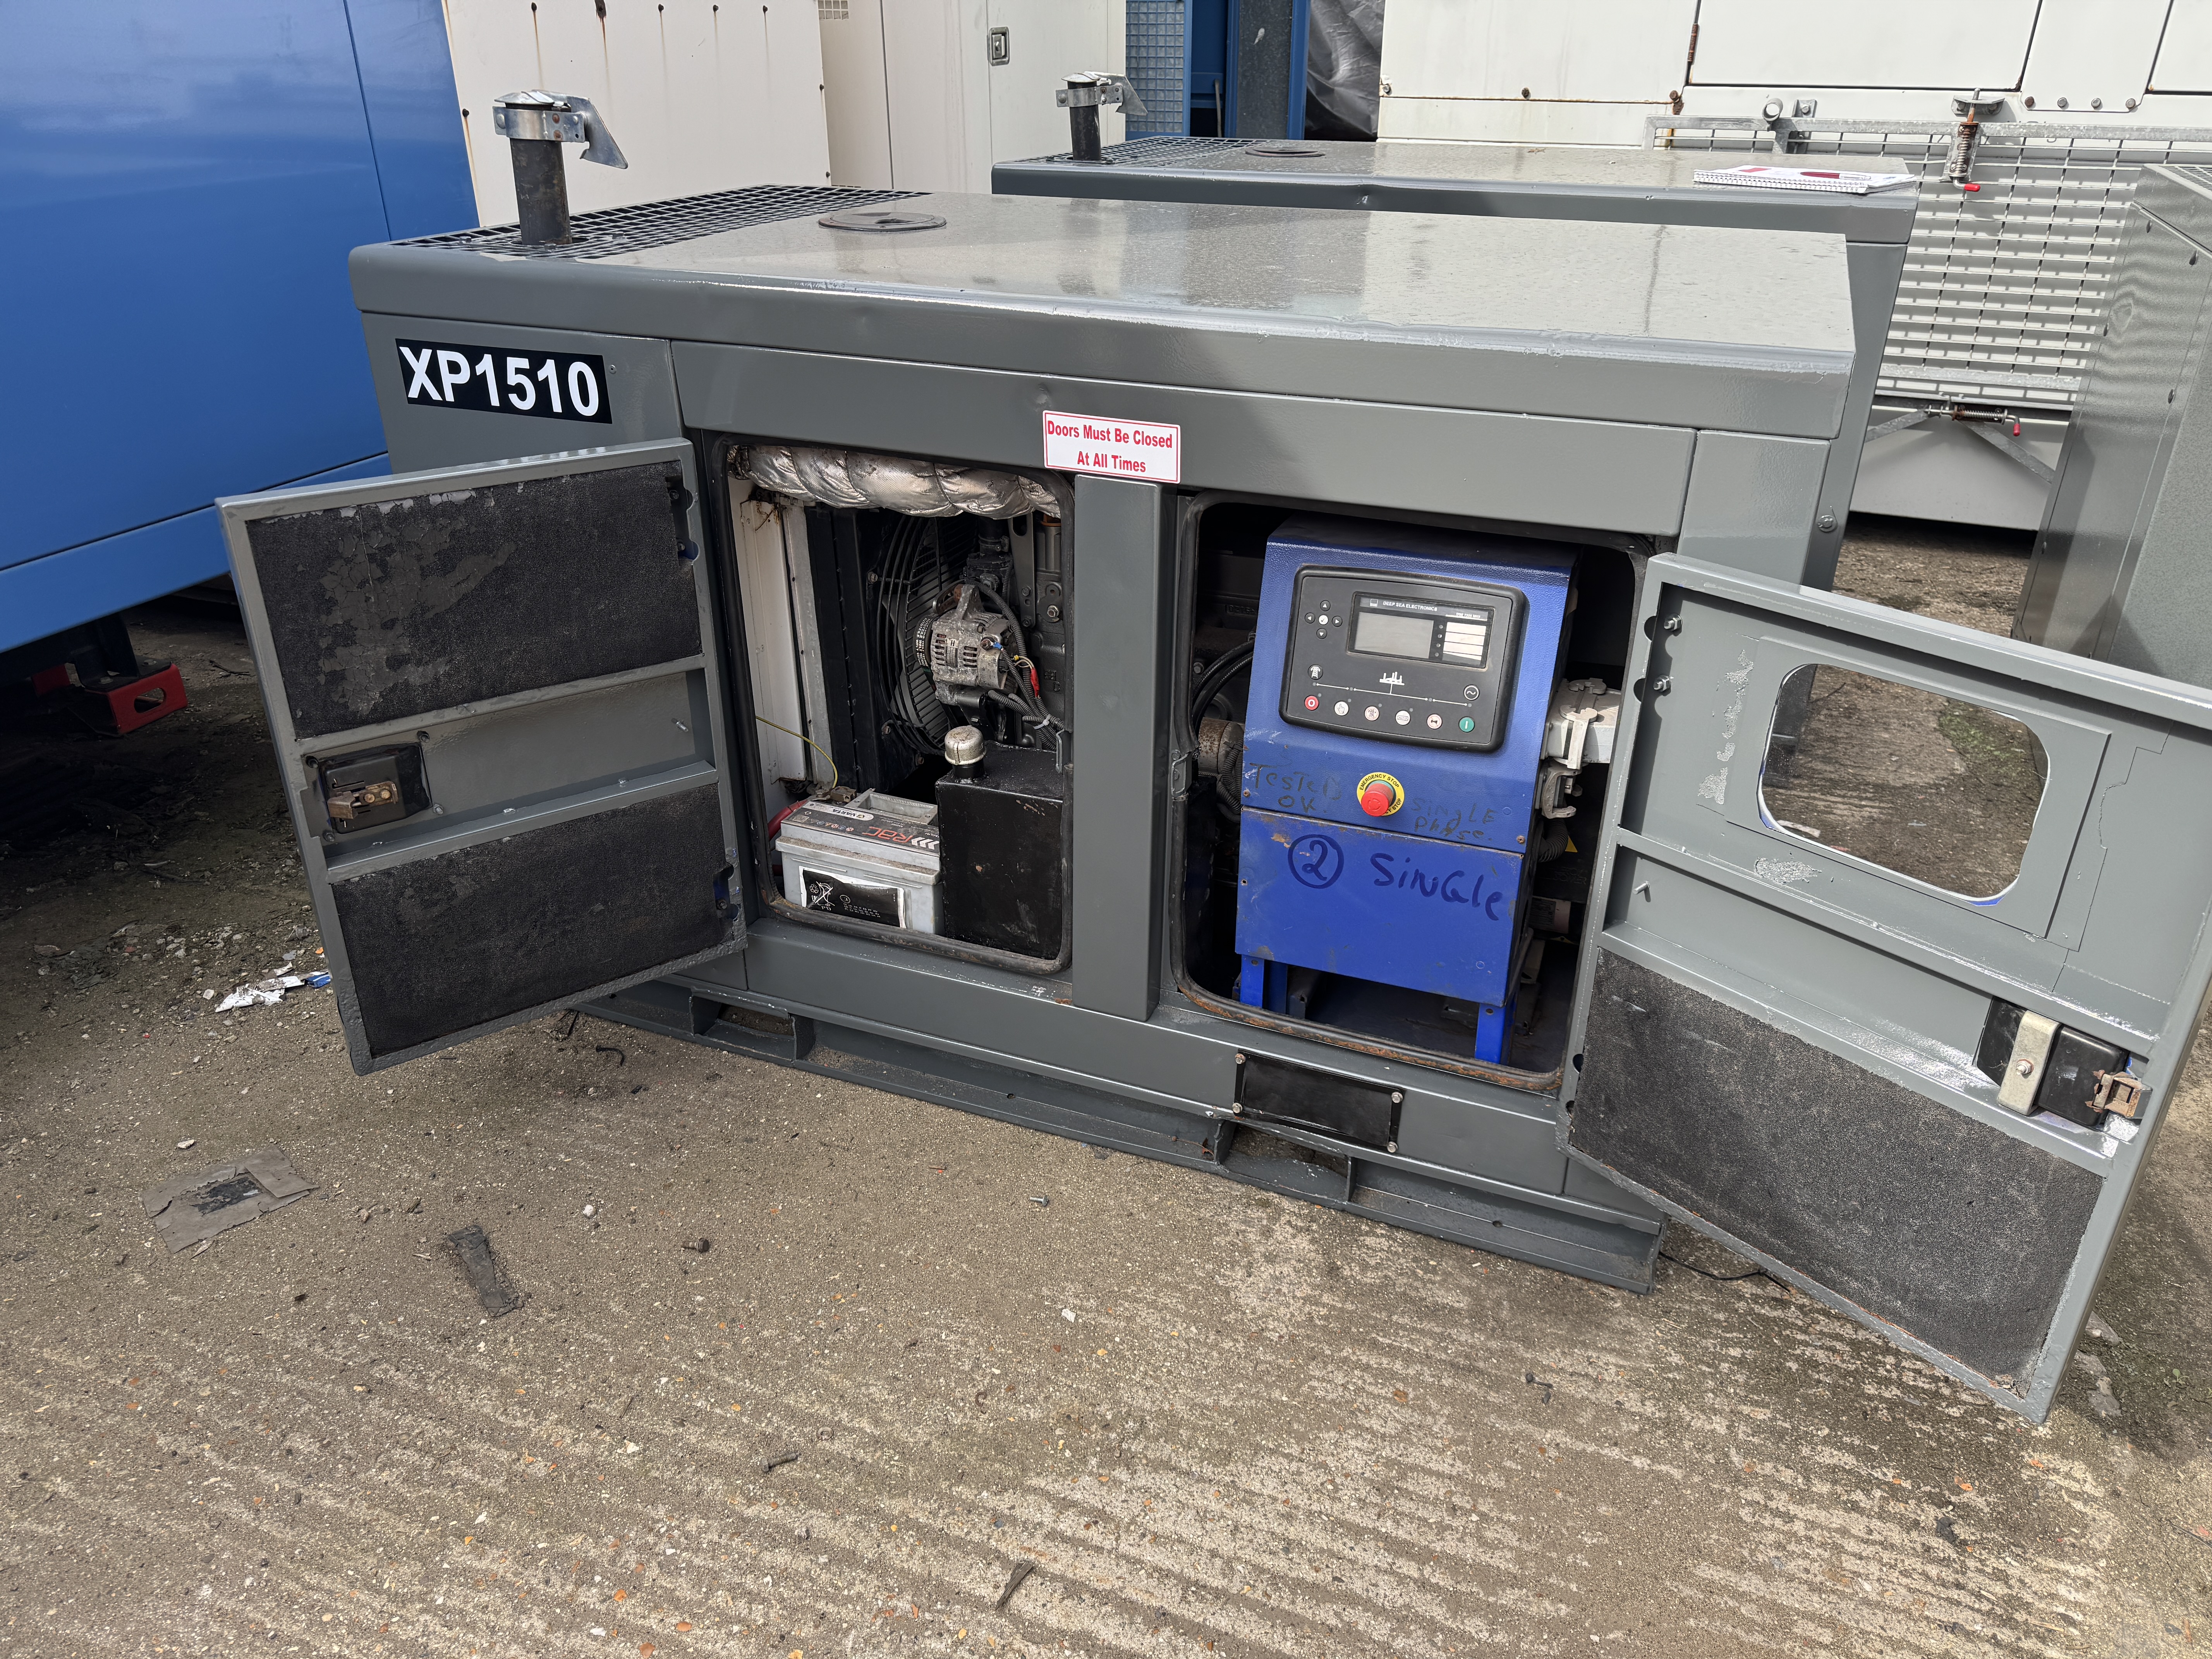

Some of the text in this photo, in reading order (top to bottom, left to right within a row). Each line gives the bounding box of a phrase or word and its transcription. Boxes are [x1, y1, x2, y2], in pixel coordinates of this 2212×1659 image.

[399, 346, 599, 417] XP1510
[1048, 420, 1172, 448] Doors Must Be Closed
[1077, 451, 1146, 472] At All Times
[1360, 774, 1399, 790] EMERGENCY STOP
[1392, 798, 1401, 810] STOP
